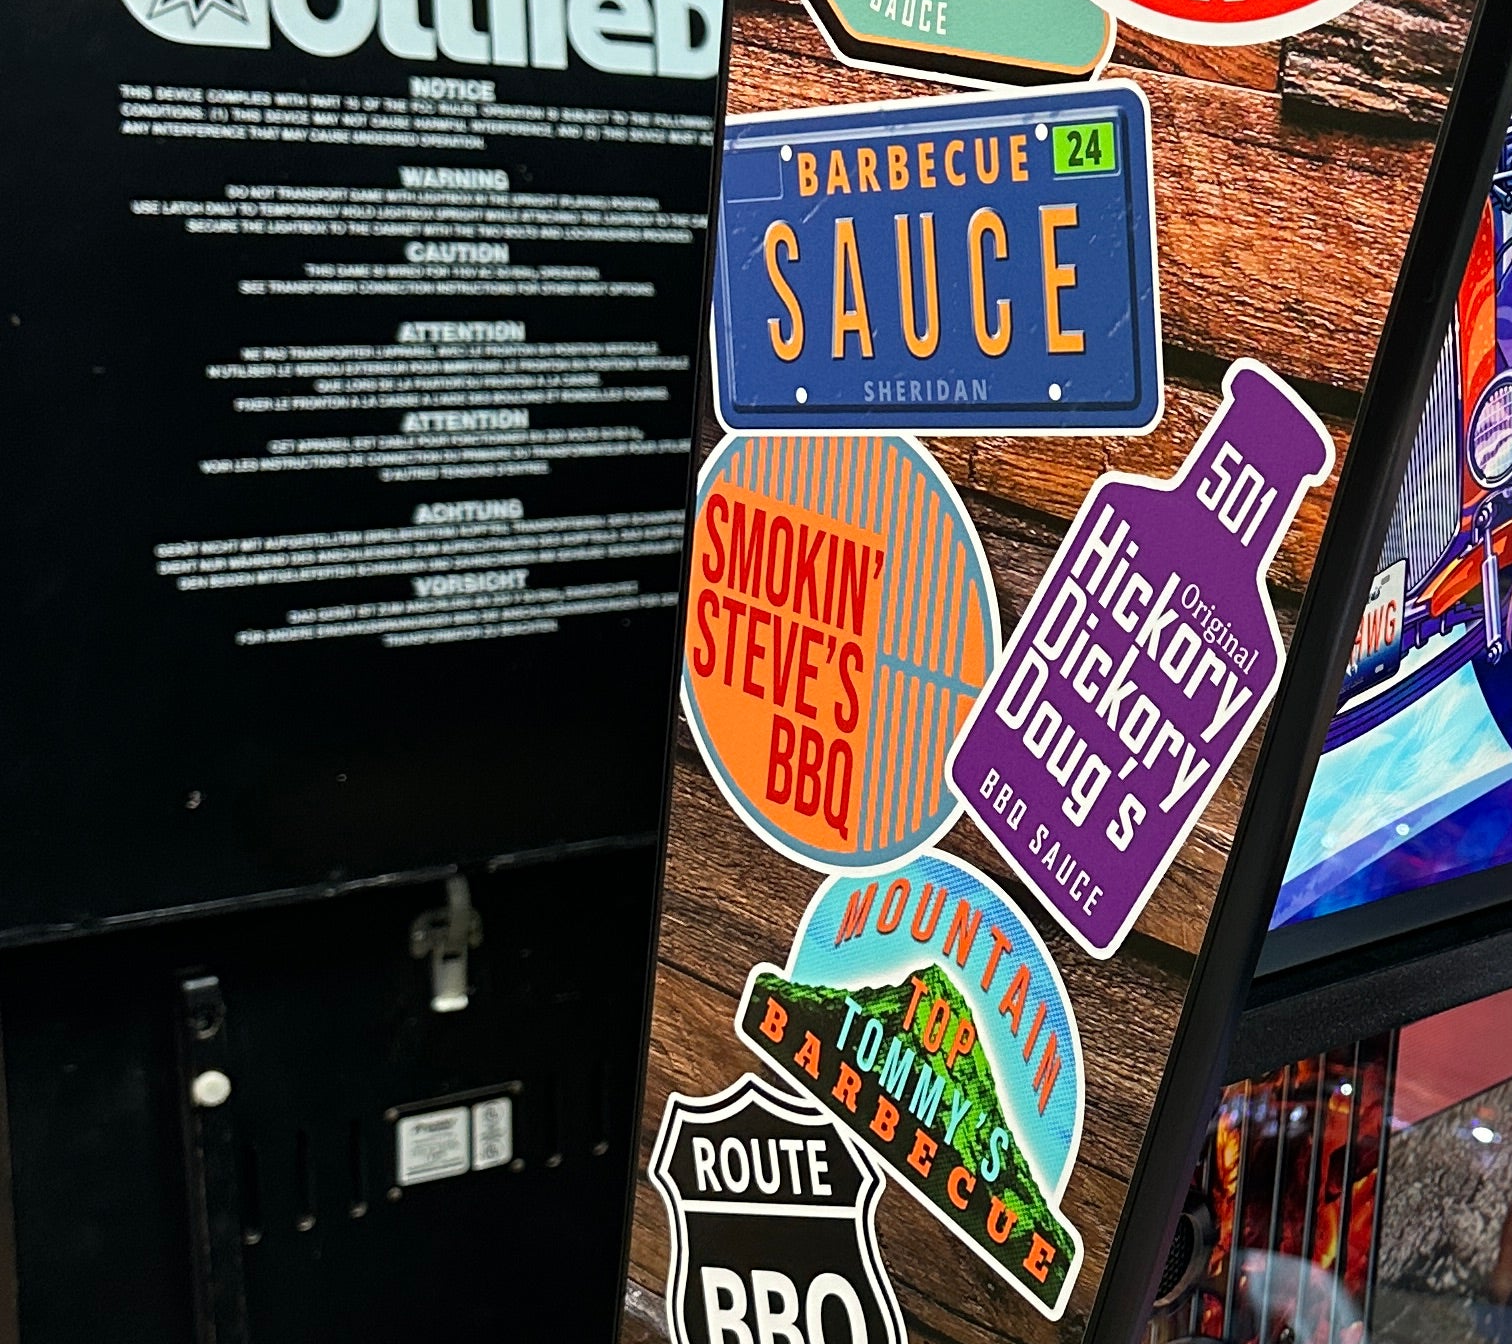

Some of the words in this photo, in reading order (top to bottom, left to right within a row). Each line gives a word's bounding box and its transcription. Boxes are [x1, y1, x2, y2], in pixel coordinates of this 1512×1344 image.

[409, 76, 496, 102] NOTICE
[399, 166, 510, 191] WARNING
[797, 134, 1029, 197] BARBECUE
[1067, 128, 1102, 168] 24
[404, 241, 509, 264] CAUTION
[763, 203, 1086, 362] SAUCE
[397, 320, 526, 344] ATTENTION
[401, 408, 530, 433] ATTENTION
[864, 378, 988, 402] SHERIDAN
[412, 498, 524, 525] ACHTUNG
[1196, 441, 1278, 546] 501
[411, 568, 530, 597] VORSICHT
[702, 493, 885, 636] SMOKIN'
[692, 589, 864, 734] STEVE'S
[1070, 503, 1253, 742] Hickory
[1180, 582, 1259, 676] Original
[1032, 575, 1211, 814] Dickory
[766, 715, 854, 841] BBQ
[995, 647, 1148, 852] Doug's
[979, 767, 1026, 827] BBQ
[1029, 822, 1105, 917] SAUCE
[835, 877, 1063, 1115] MOUNTAIN
[901, 975, 976, 1069] TOP
[836, 996, 1011, 1183] TOMMY'S
[691, 1135, 834, 1197] ROUTE
[759, 997, 1058, 1283] BARBECUE
